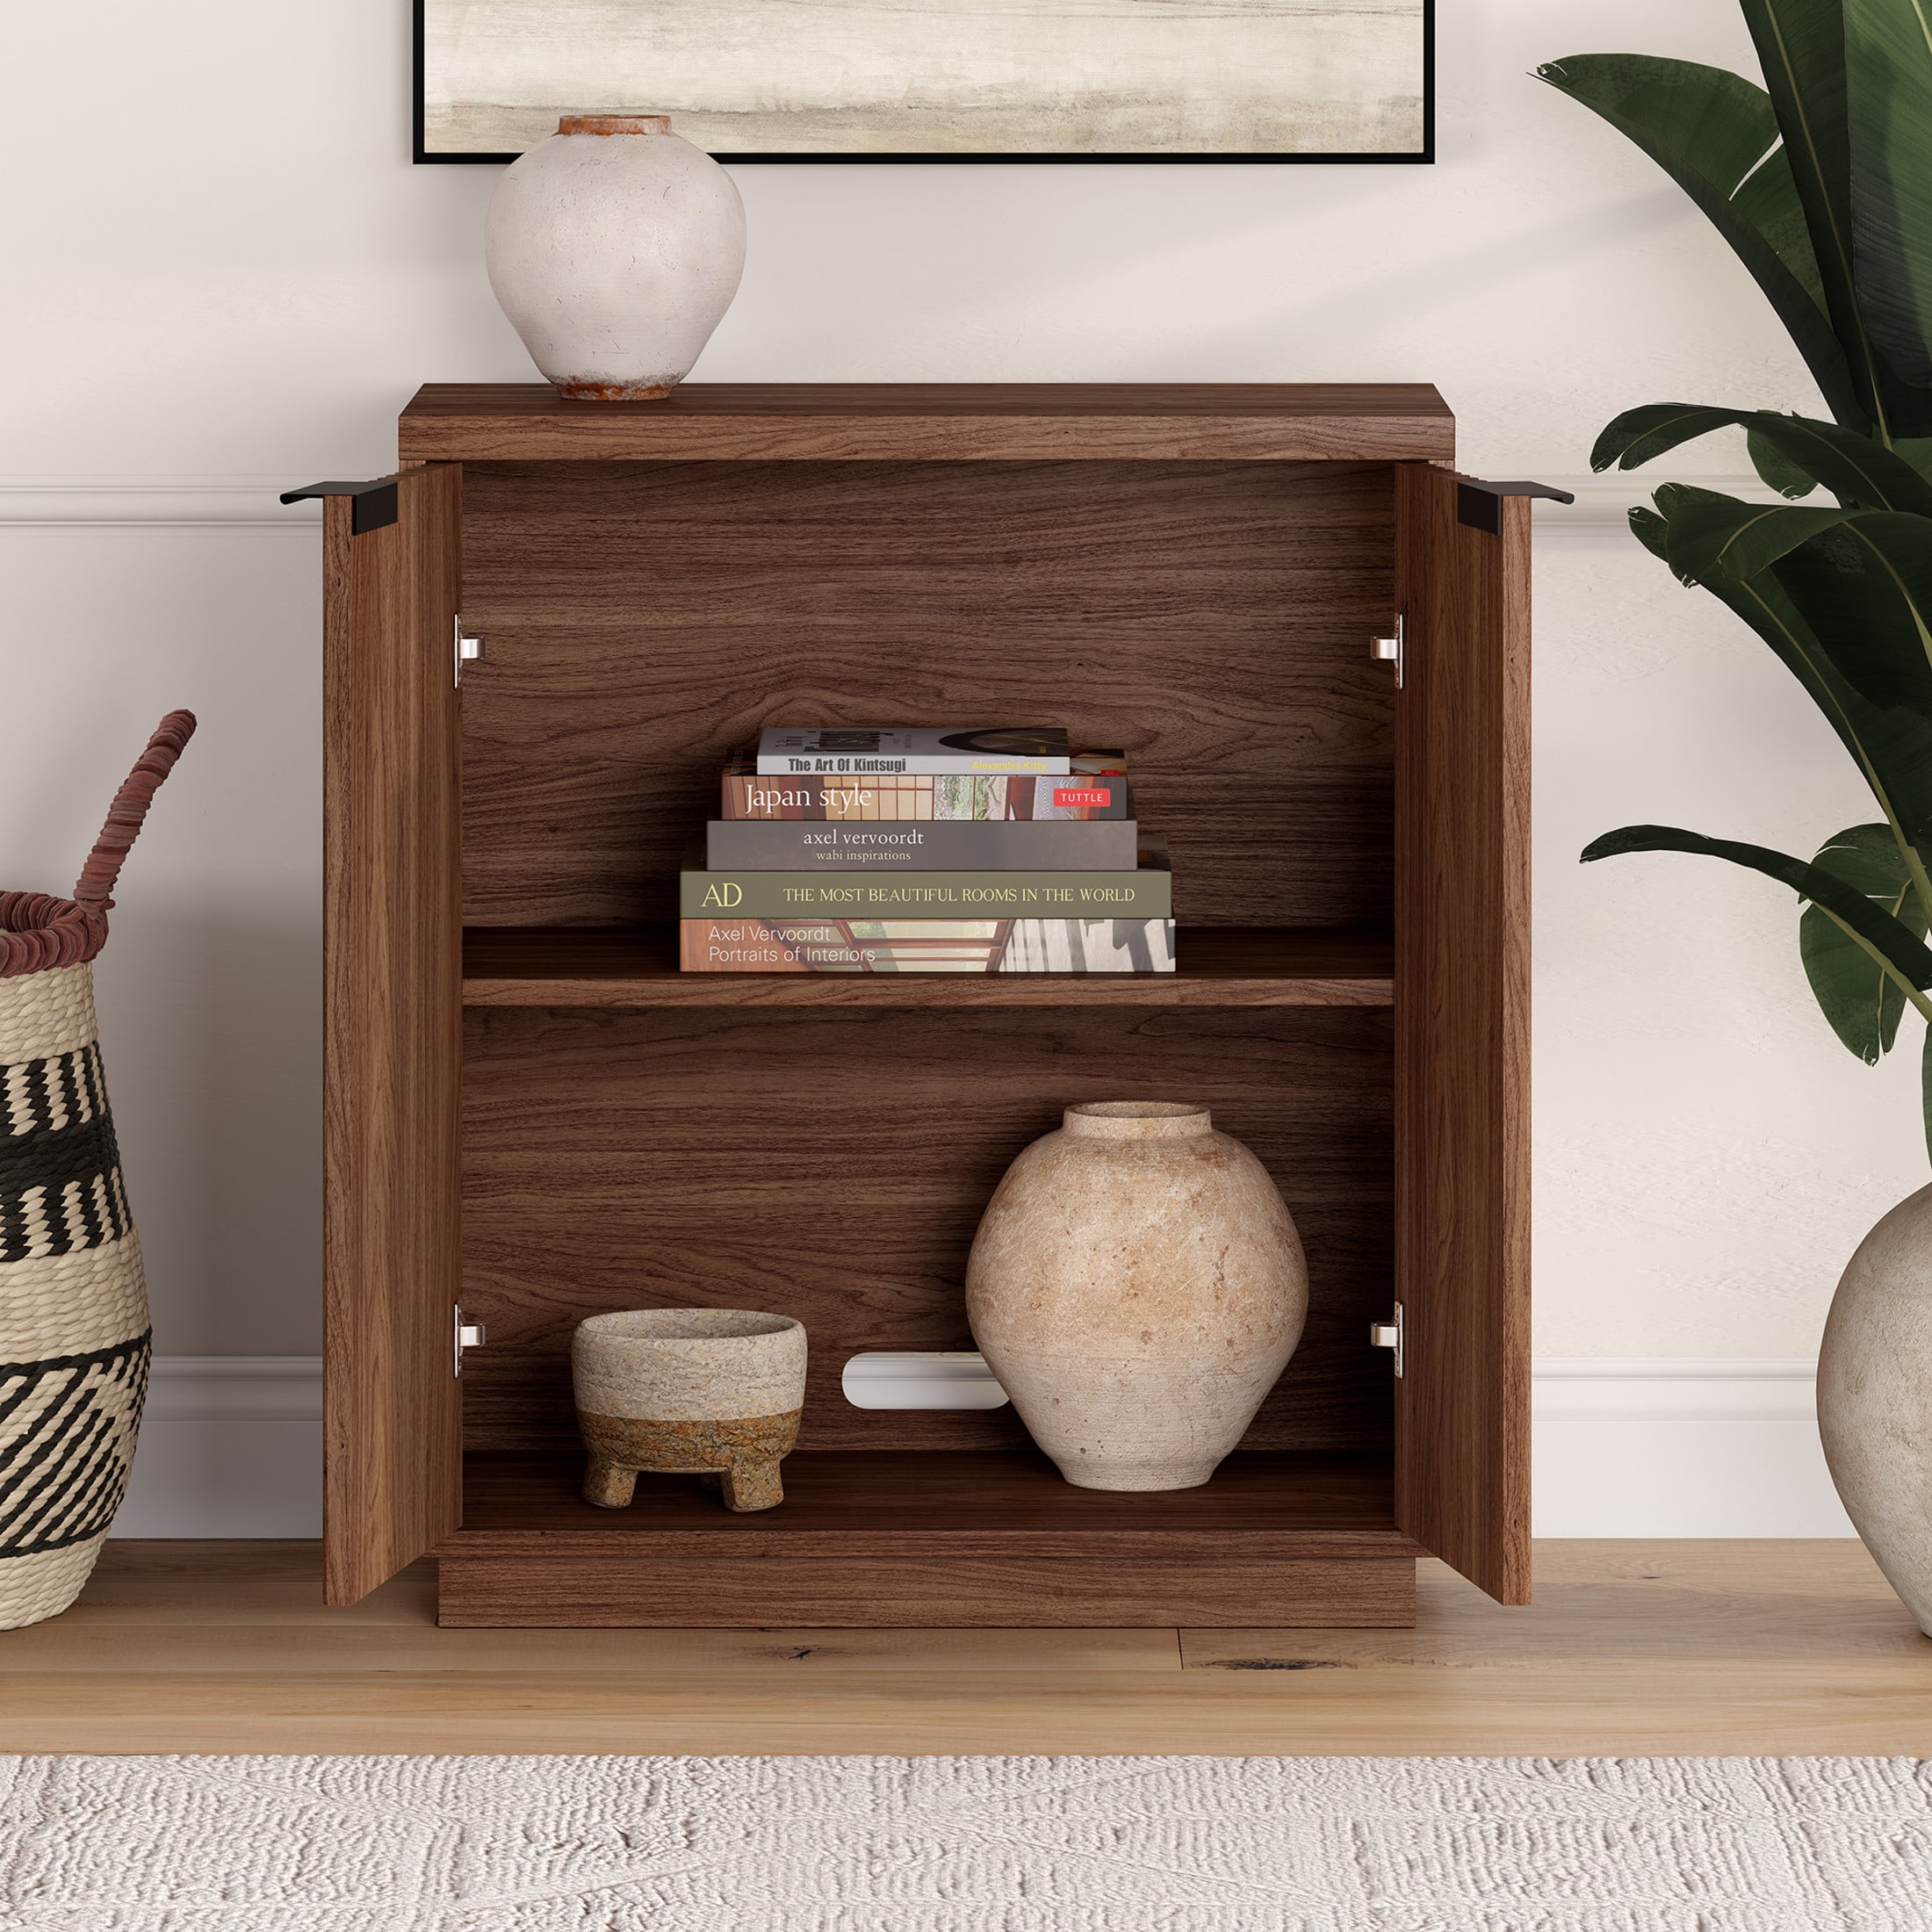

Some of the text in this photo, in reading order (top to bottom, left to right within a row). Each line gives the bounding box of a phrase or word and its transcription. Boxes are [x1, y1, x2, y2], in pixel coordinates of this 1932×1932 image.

[789, 759, 906, 773] The Art Of Kintsugi
[972, 761, 1047, 772] Alexandra Kitty
[745, 783, 872, 814] Japan style
[1061, 793, 1103, 802] TUTTLE
[803, 829, 924, 845] axel vervoordt
[816, 850, 911, 863] wabi inspirations
[701, 883, 743, 907] AD
[783, 888, 1135, 902] THE MOST BEAUTIFUL ROOMS IN THE WORLD
[708, 926, 831, 941] Axel Vervoordt
[709, 946, 876, 962] Portraits of Interiors
